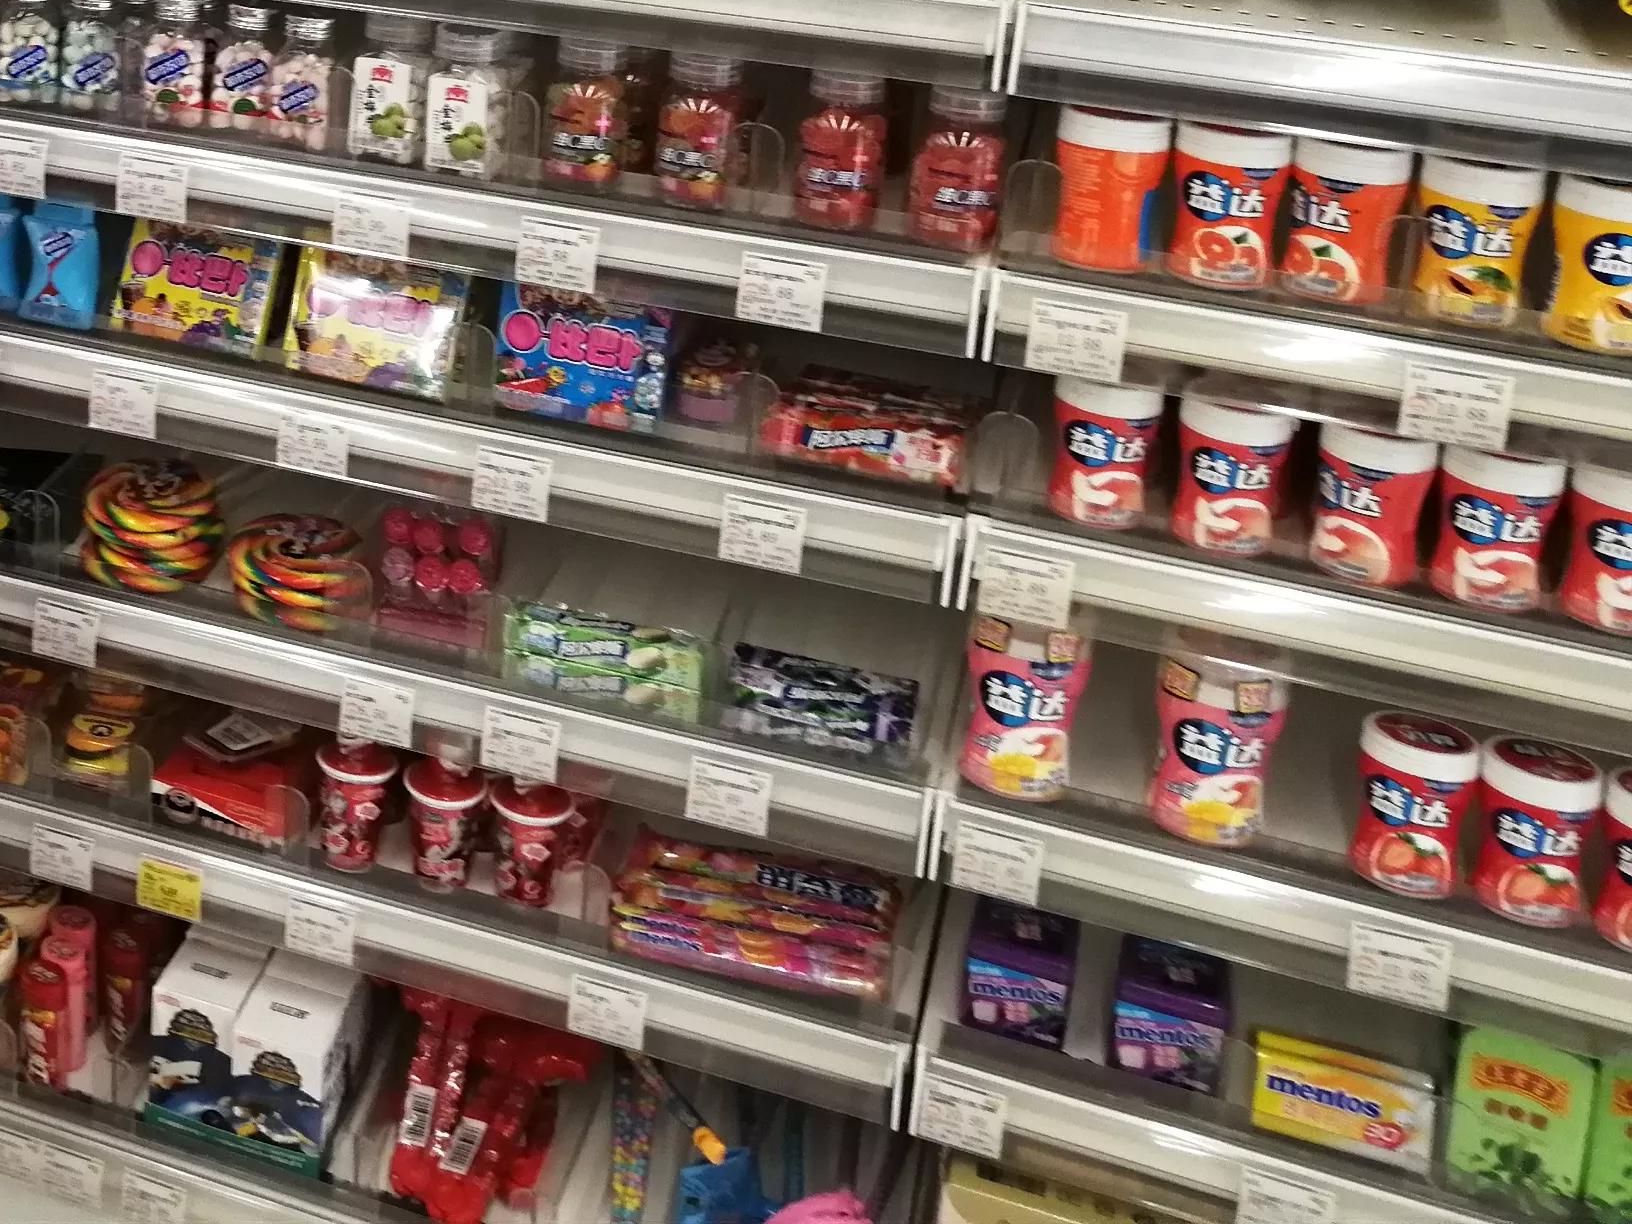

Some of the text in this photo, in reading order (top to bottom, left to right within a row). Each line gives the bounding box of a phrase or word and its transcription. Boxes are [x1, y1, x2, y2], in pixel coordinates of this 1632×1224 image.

[1185, 169, 1266, 220] 益达
[1428, 204, 1514, 258] 益达
[1067, 419, 1148, 466] 益达
[1192, 446, 1273, 493] 益达
[1451, 494, 1543, 544] 益达
[982, 672, 1067, 727] 益达
[1177, 719, 1266, 775] 益达
[1367, 777, 1451, 830] 益达
[1495, 809, 1582, 860] 益达
[971, 979, 1064, 1006] mentos
[1117, 1022, 1213, 1051] mentos
[1266, 1072, 1383, 1121] mentos
